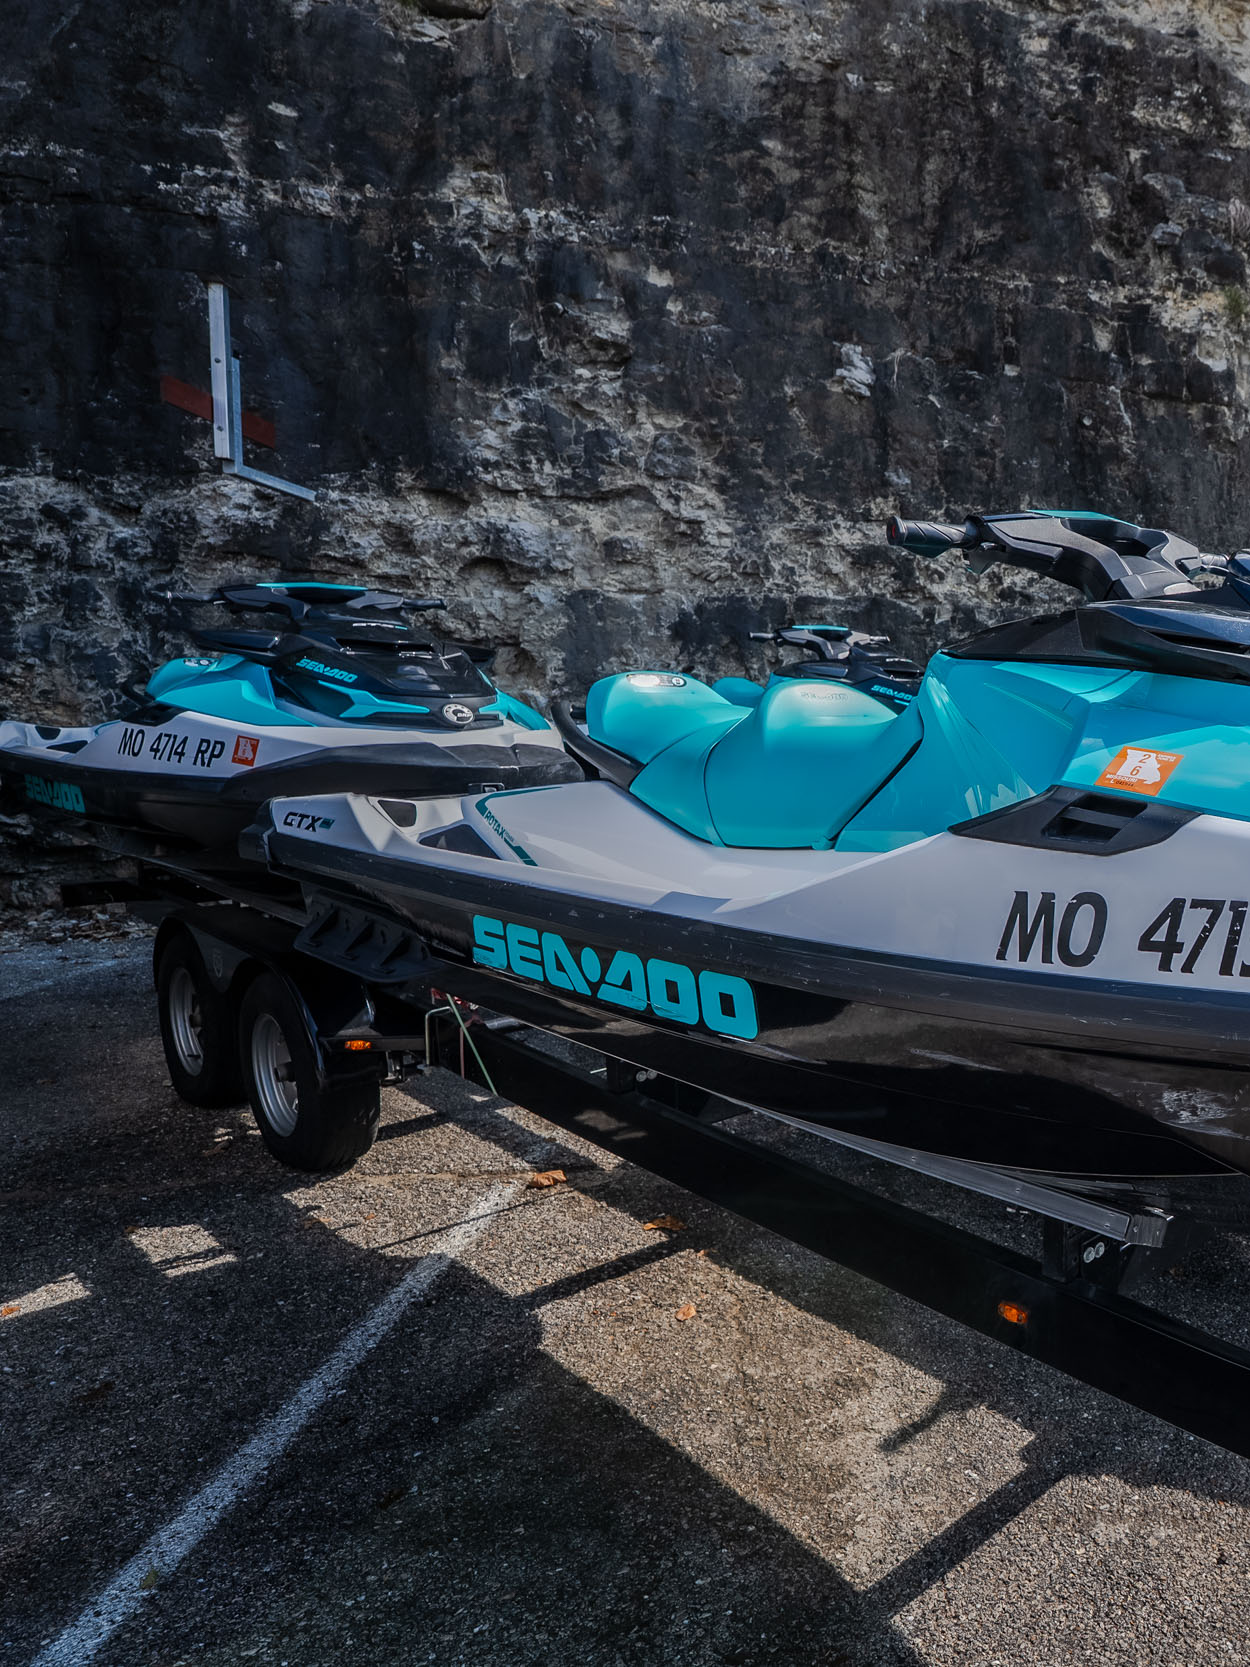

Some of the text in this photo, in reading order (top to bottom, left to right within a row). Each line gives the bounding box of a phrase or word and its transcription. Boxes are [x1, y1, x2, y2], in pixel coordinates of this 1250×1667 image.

[117, 727, 146, 757] MO
[149, 732, 189, 764] 4714
[193, 738, 226, 768] RP
[1138, 753, 1152, 764] 2
[1130, 765, 1143, 777] 6
[283, 811, 323, 832] GTX
[484, 809, 506, 840] ROTAX
[995, 890, 1108, 968] MO
